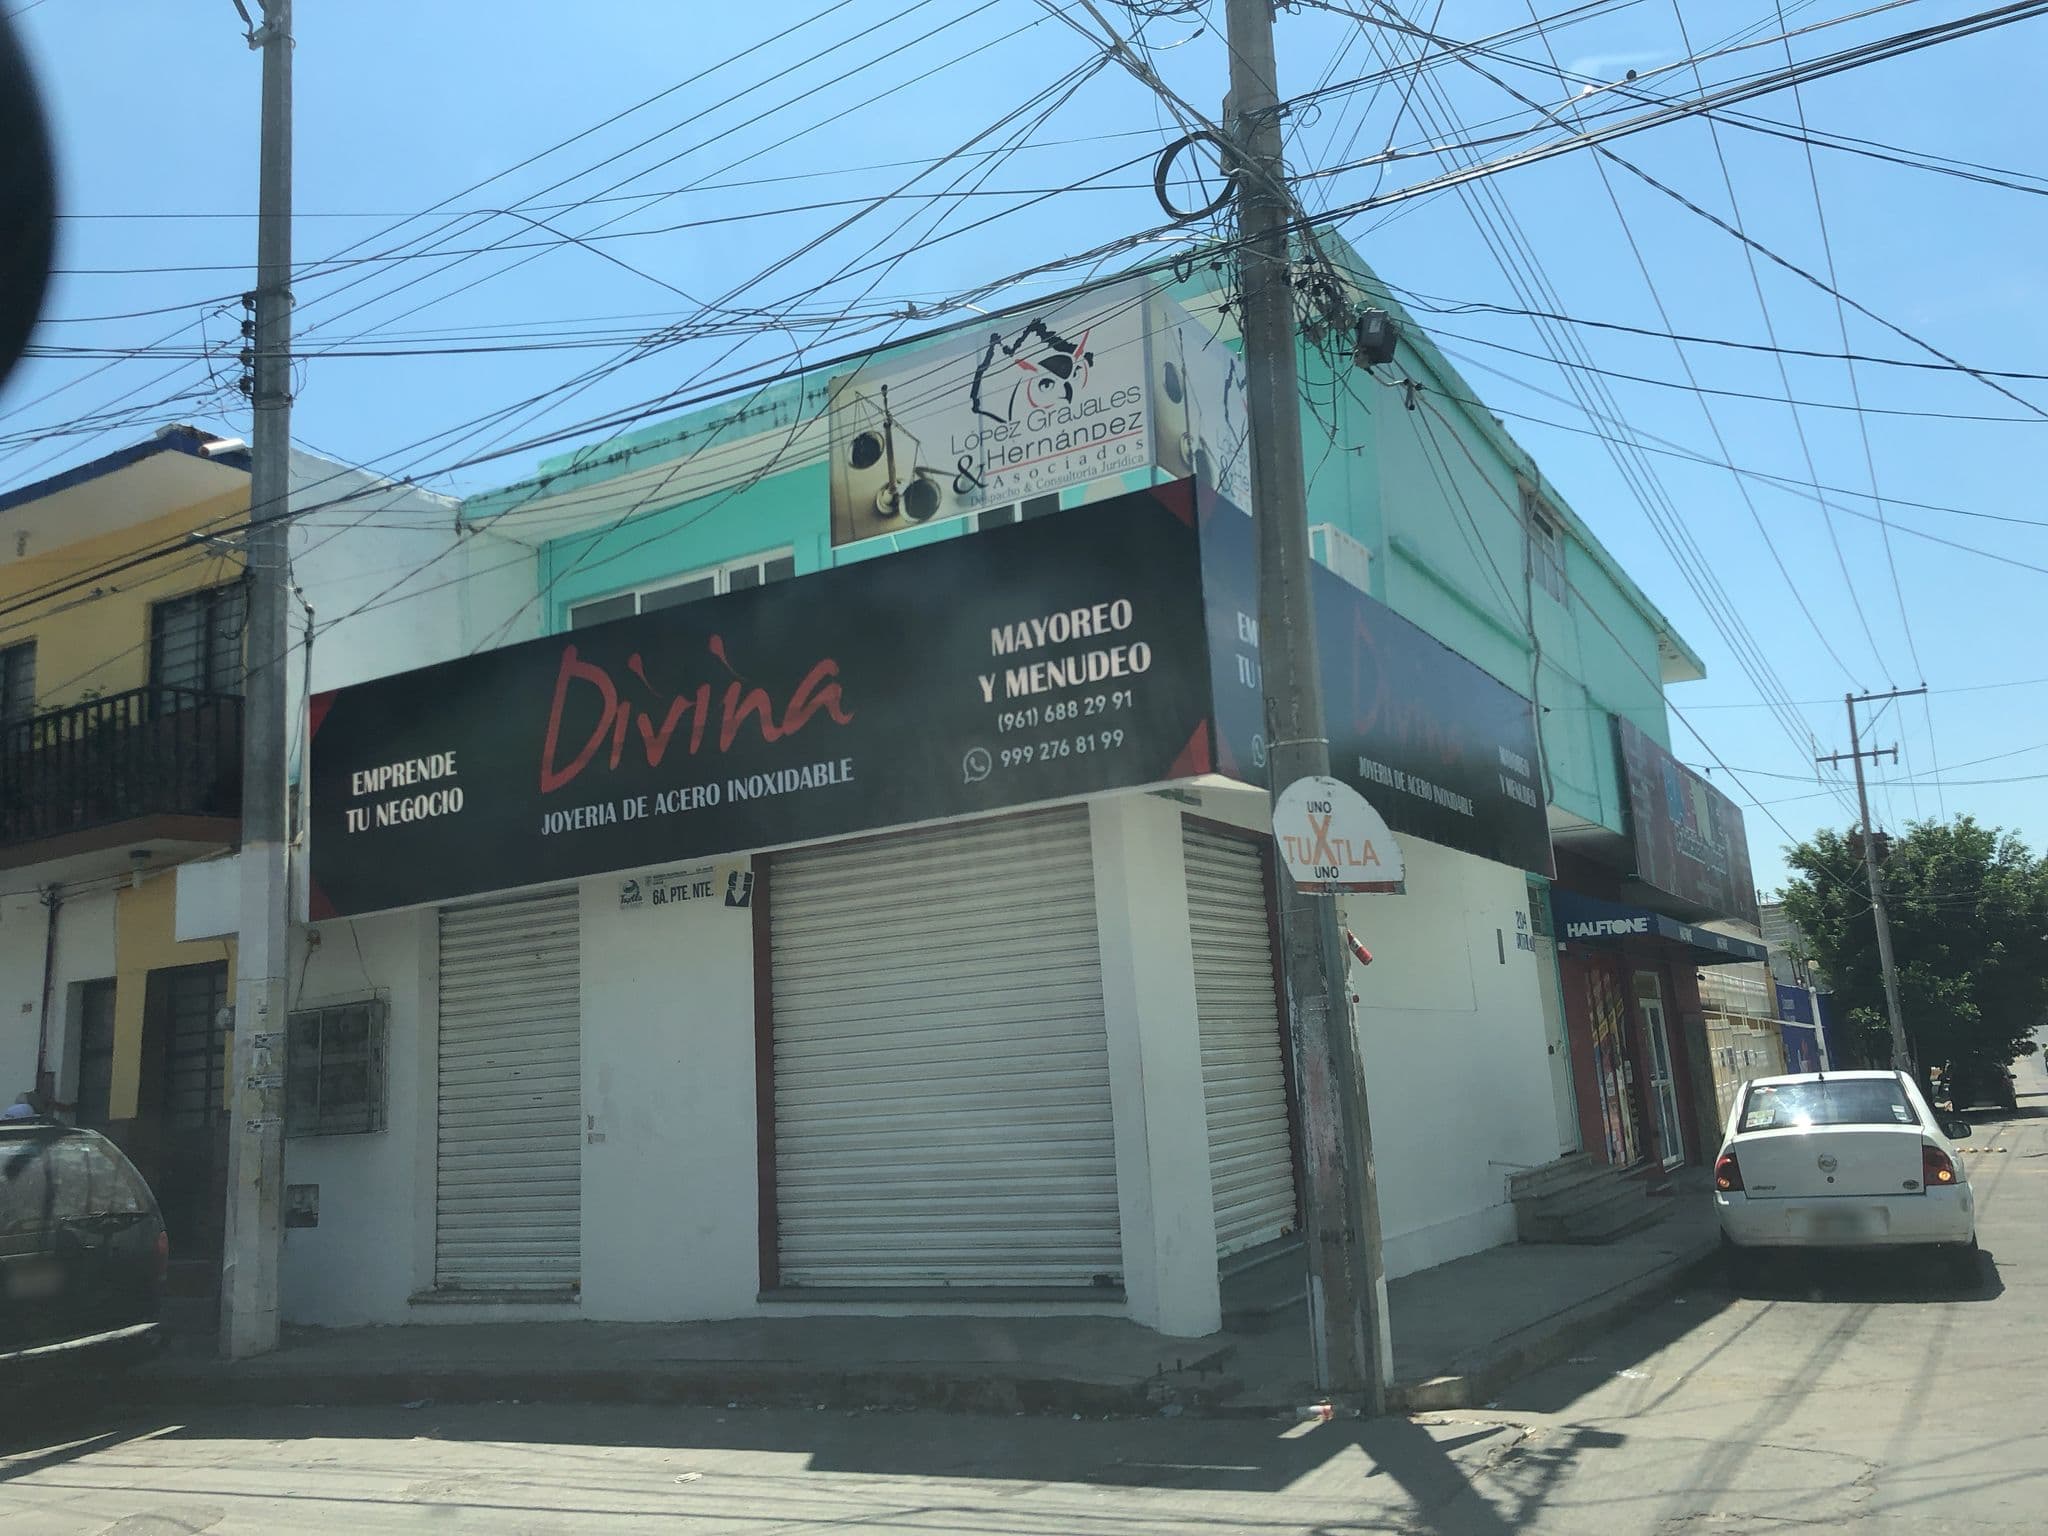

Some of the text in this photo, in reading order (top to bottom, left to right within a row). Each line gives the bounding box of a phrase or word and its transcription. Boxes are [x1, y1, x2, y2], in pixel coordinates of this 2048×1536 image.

[1027, 386, 1142, 432] Grajales
[953, 455, 988, 495] &
[993, 439, 1144, 490] Asociados
[991, 599, 1133, 657] MAYOREO
[978, 641, 1152, 703] Y MENUDEO
[541, 634, 855, 795] Divina
[998, 690, 1133, 732] (961) 688 29 91
[1000, 729, 1124, 768] 999 276 81 99
[352, 751, 458, 796] EMPRENDE
[345, 787, 464, 833] TU NEGOCIO
[541, 758, 855, 836] JOYERIA DE ACERO INOXIDABLE
[1307, 801, 1332, 814] UNO
[1283, 814, 1381, 866] TUXTLA
[670, 885, 690, 902] PTE.
[693, 881, 714, 899] NTE.
[1314, 866, 1339, 879] UNO
[1567, 917, 1648, 938] HALFTONE
